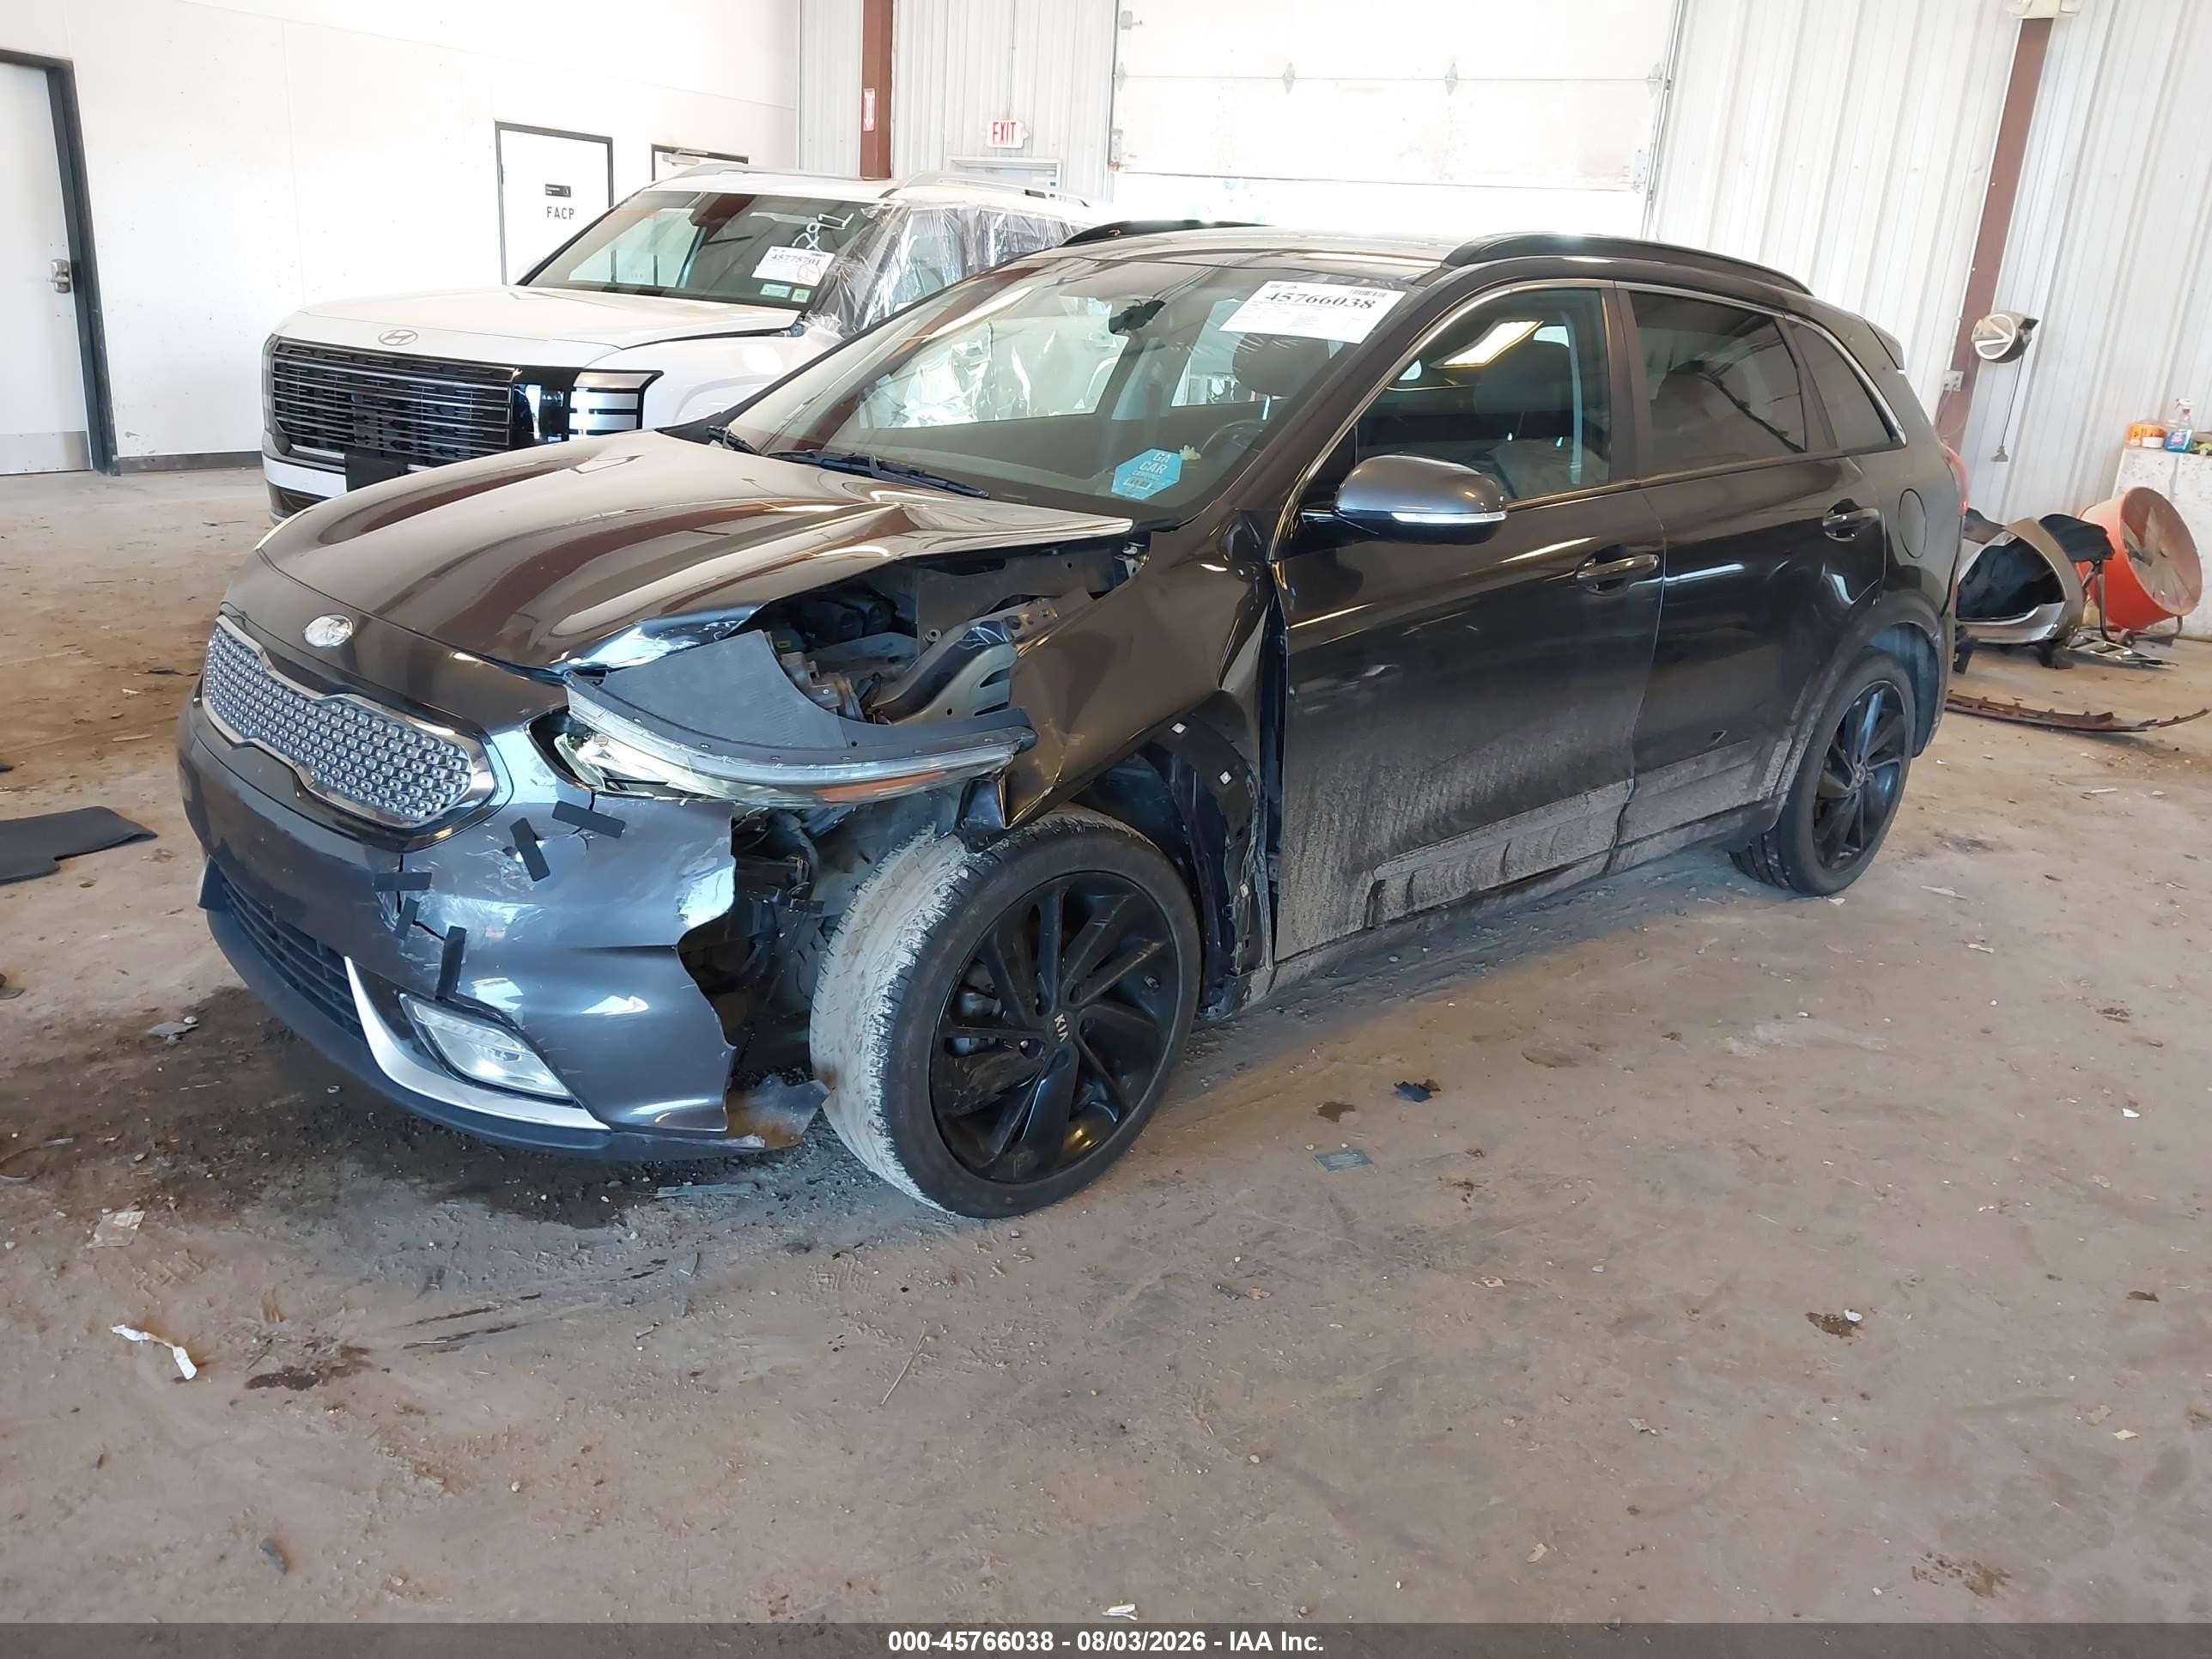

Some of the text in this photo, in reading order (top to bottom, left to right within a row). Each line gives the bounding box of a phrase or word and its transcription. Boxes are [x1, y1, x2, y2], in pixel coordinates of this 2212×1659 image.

[993, 121, 1016, 144] EXIT
[546, 205, 574, 220] FACP
[1265, 291, 1376, 309] 45766038
[1139, 461, 1168, 475] CAR
[1054, 1012, 1069, 1043] KIA
